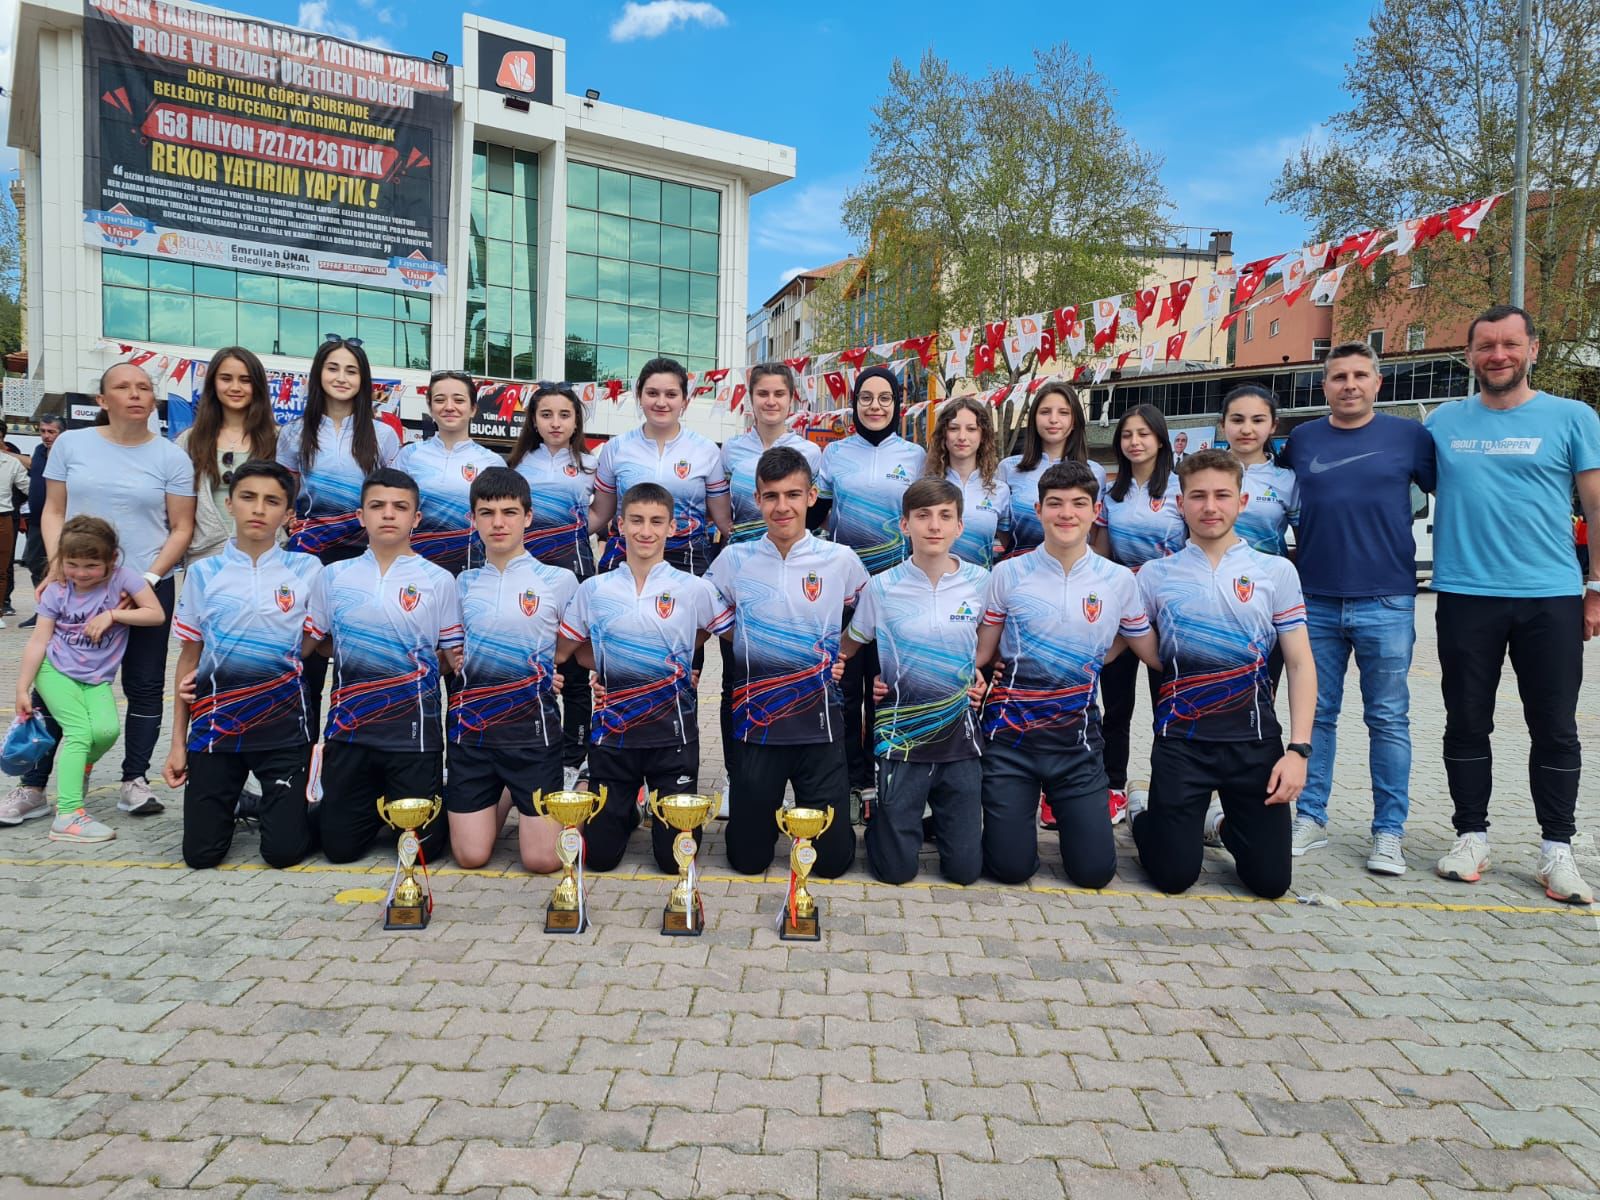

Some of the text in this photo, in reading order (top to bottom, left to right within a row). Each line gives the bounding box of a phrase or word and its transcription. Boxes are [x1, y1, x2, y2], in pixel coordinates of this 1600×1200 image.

[89, 0, 151, 21] UCAK
[249, 23, 269, 48] EN
[272, 29, 318, 59] FAZLA
[322, 40, 384, 74] YATIRIM
[133, 26, 188, 60] PROJE
[191, 39, 213, 65] VE
[187, 69, 370, 120] DÖRT YILLIK GÖREV SÜREMDE
[156, 109, 188, 139] 158
[192, 114, 254, 152] MİLYON
[258, 129, 338, 167] 727.721,26
[290, 109, 347, 133] YATIRIMA
[349, 121, 396, 141] AYIRDIK
[152, 141, 217, 182] REKOR
[222, 155, 299, 196] YATIRIM
[304, 170, 366, 207] YAPTIK
[231, 244, 310, 263] Emrullah ÜNAL
[232, 254, 310, 272] Belediye Başkanı
[470, 423, 506, 437] BUCAK
[1450, 440, 1478, 449] ABOUT
[1481, 440, 1492, 449] TO
